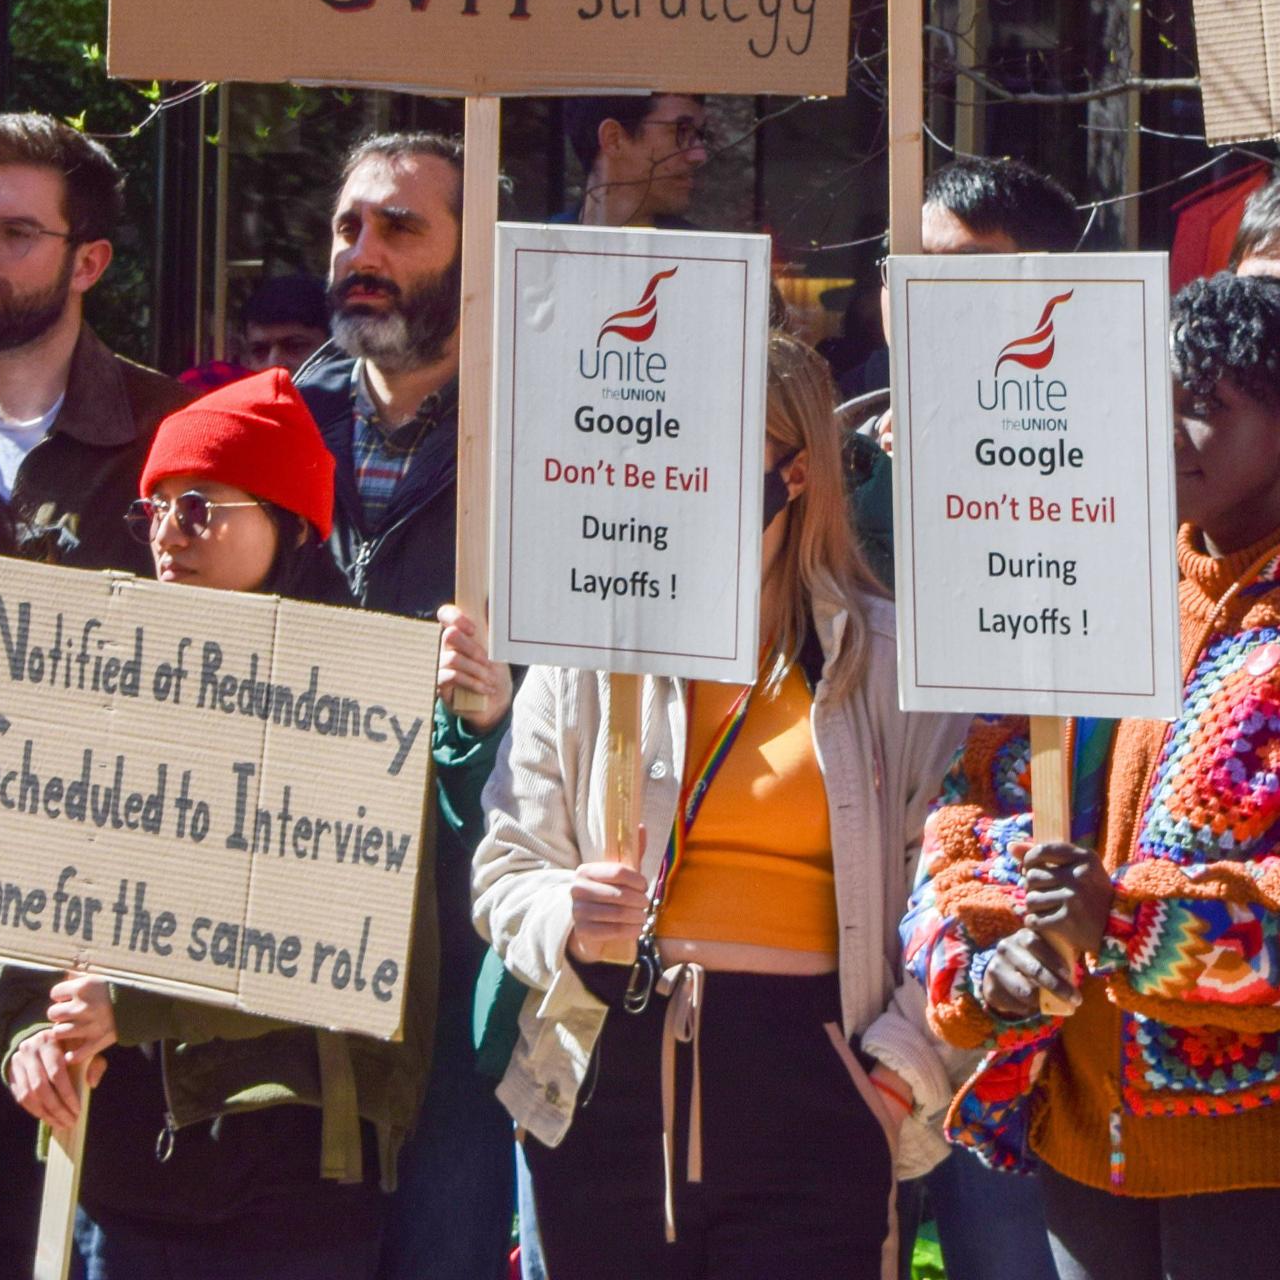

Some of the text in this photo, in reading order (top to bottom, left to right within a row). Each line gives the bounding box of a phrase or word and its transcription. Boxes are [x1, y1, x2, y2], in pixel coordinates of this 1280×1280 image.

[579, 346, 667, 384] unite
[977, 373, 1067, 412] unite
[574, 406, 680, 444] Google
[544, 457, 709, 493] Don't Be Evil
[975, 438, 1084, 476] Google
[946, 493, 1116, 524] Don't Be Evil
[582, 515, 668, 551] During
[570, 568, 677, 600] Layoffs !
[988, 552, 1077, 586] During
[978, 607, 1088, 640] Layoffs !
[152, 637, 192, 704] of
[196, 640, 423, 775] Redundancy
[175, 769, 210, 845] to
[225, 761, 411, 874] Interview
[53, 866, 102, 941] for
[111, 880, 177, 957] the
[186, 917, 300, 978] same
[310, 917, 399, 1002] role
